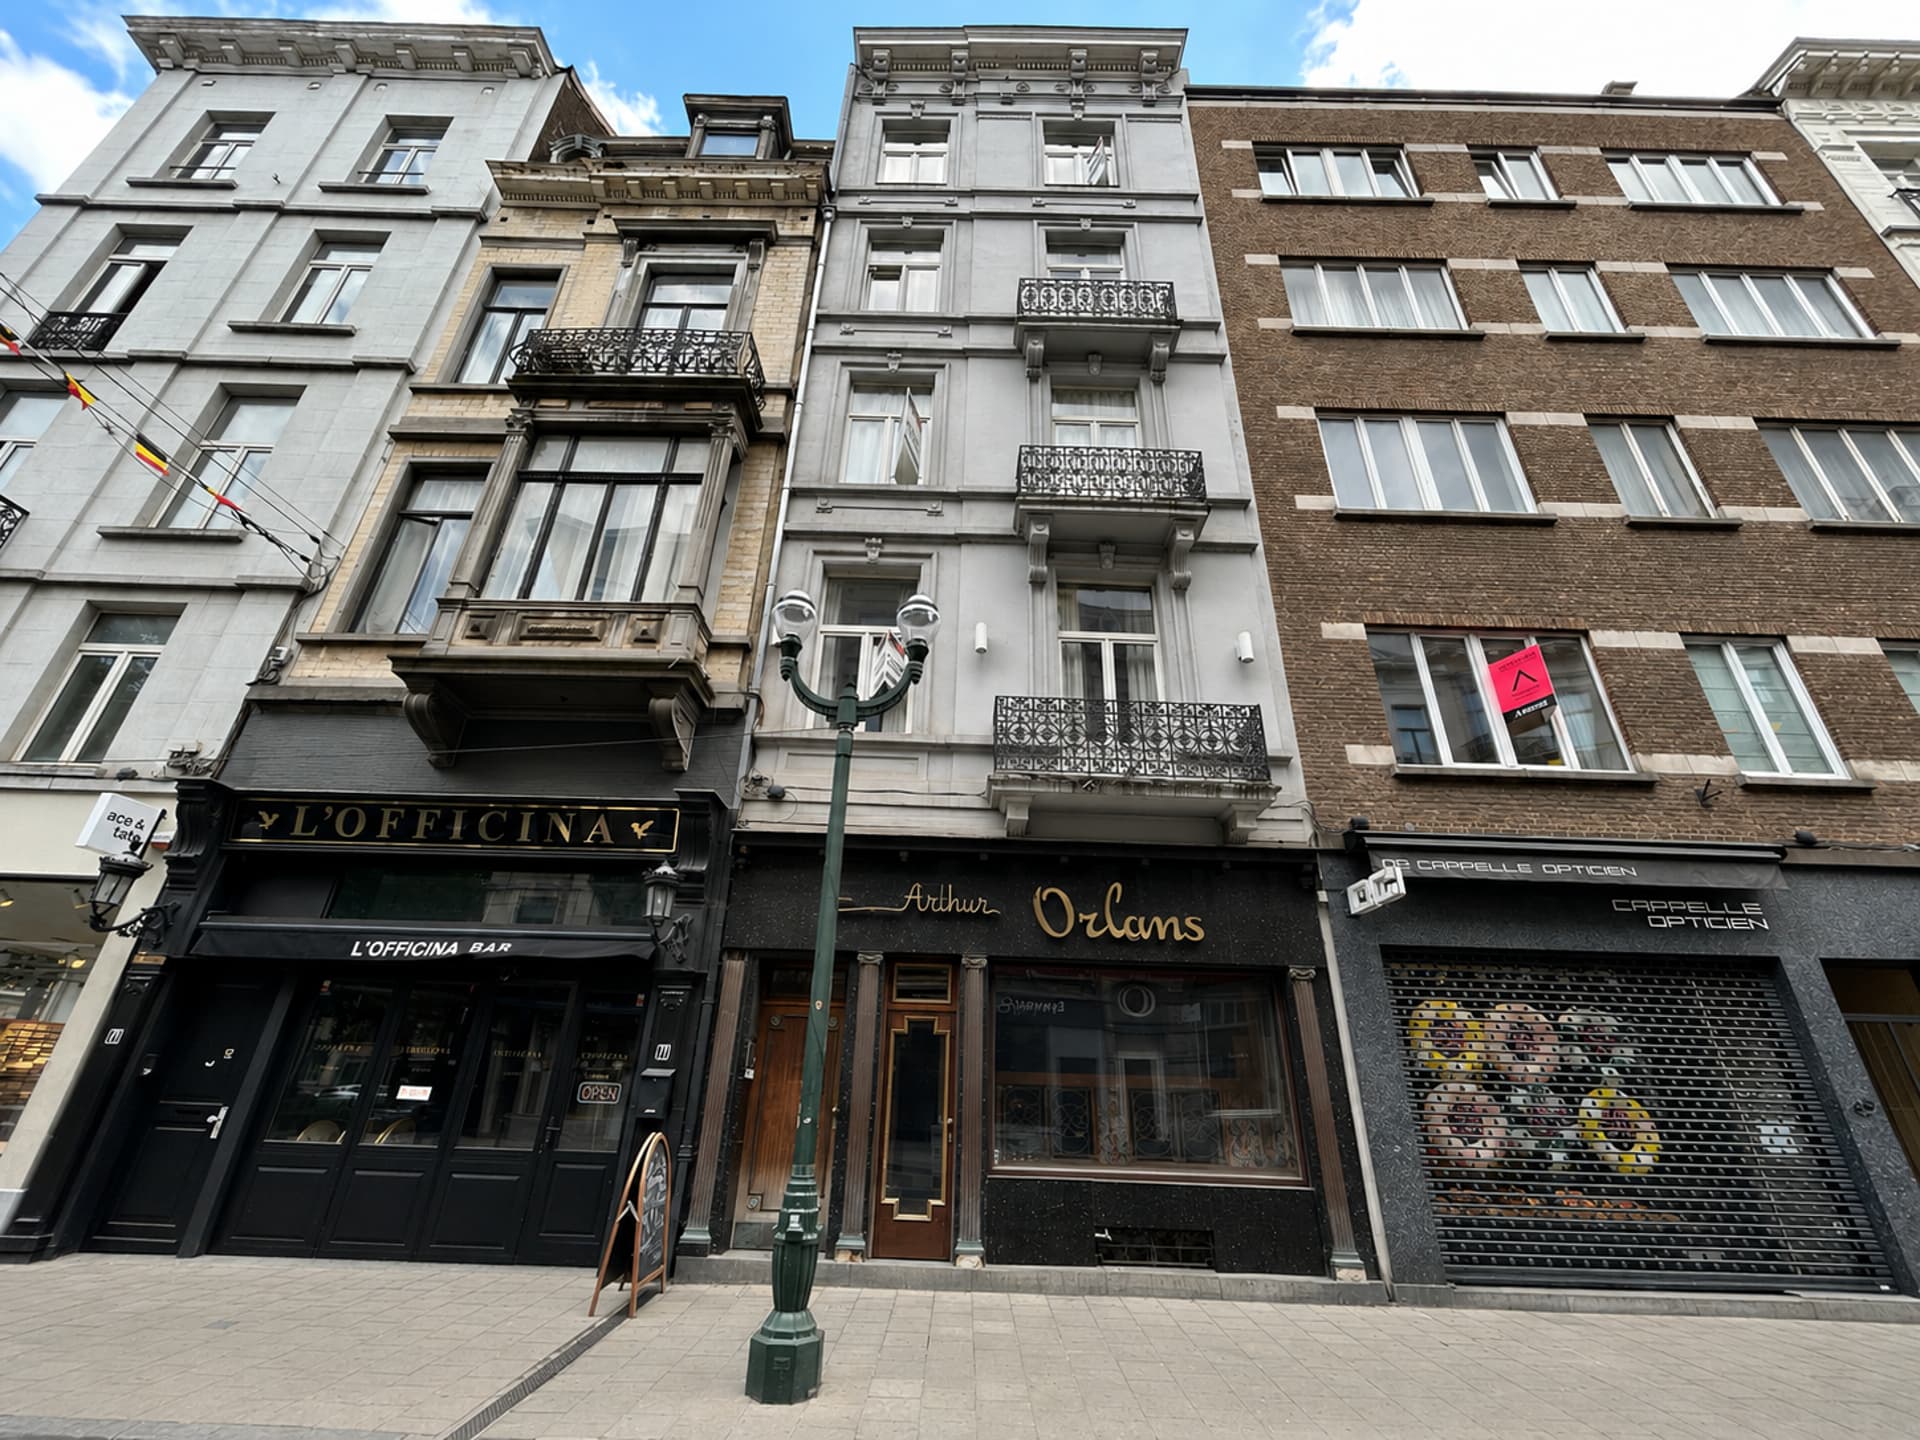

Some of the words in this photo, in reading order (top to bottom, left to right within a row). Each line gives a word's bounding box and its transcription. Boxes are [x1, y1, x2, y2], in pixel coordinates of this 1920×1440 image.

[106, 811, 133, 827] ace
[134, 819, 145, 831] &
[290, 805, 615, 844] L’OFFICINA
[1417, 860, 1533, 874] CAPPELLE
[1542, 864, 1638, 877] OPTICIEN
[901, 882, 1001, 914] Arthur
[1033, 882, 1205, 942] Orlans
[1612, 899, 1763, 915] CAPPELLE
[1647, 915, 1769, 930] OPTICIEN
[350, 941, 459, 957] L'OFFICINA
[468, 942, 513, 953] BAR
[581, 1085, 618, 1100] OPEN
